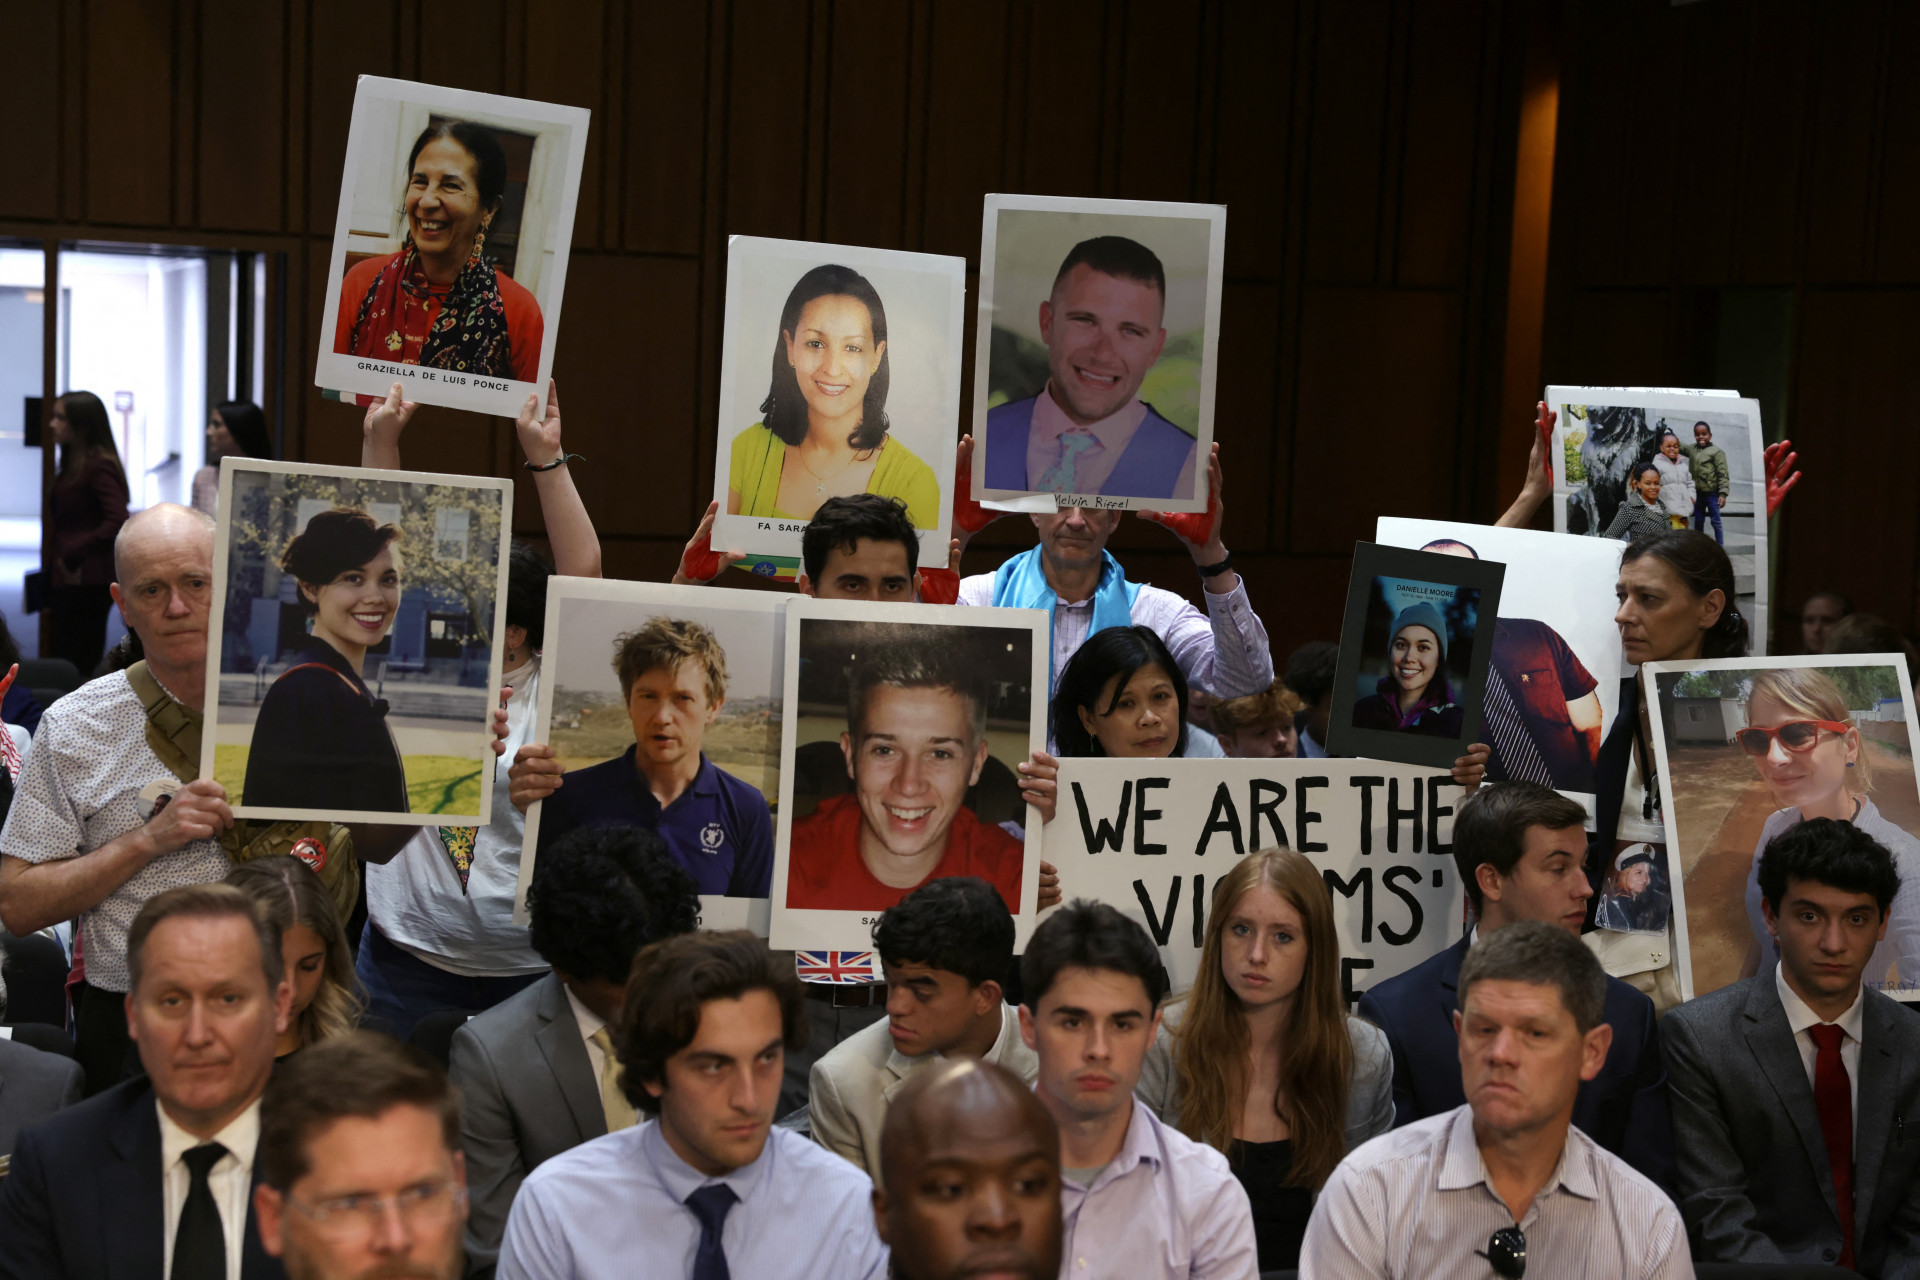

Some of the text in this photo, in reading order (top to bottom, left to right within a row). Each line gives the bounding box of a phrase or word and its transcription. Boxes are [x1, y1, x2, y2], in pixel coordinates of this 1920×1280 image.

[357, 362, 509, 392] GRAZIELLA DE LUIS PONCE
[1095, 496, 1129, 509] Riffel
[758, 522, 807, 533] FA SARA
[1396, 584, 1428, 594] DANIELLE
[1429, 588, 1455, 598] MOORE
[1071, 775, 1466, 855] WE ARE THE
[1133, 866, 1443, 949] VIMS'
